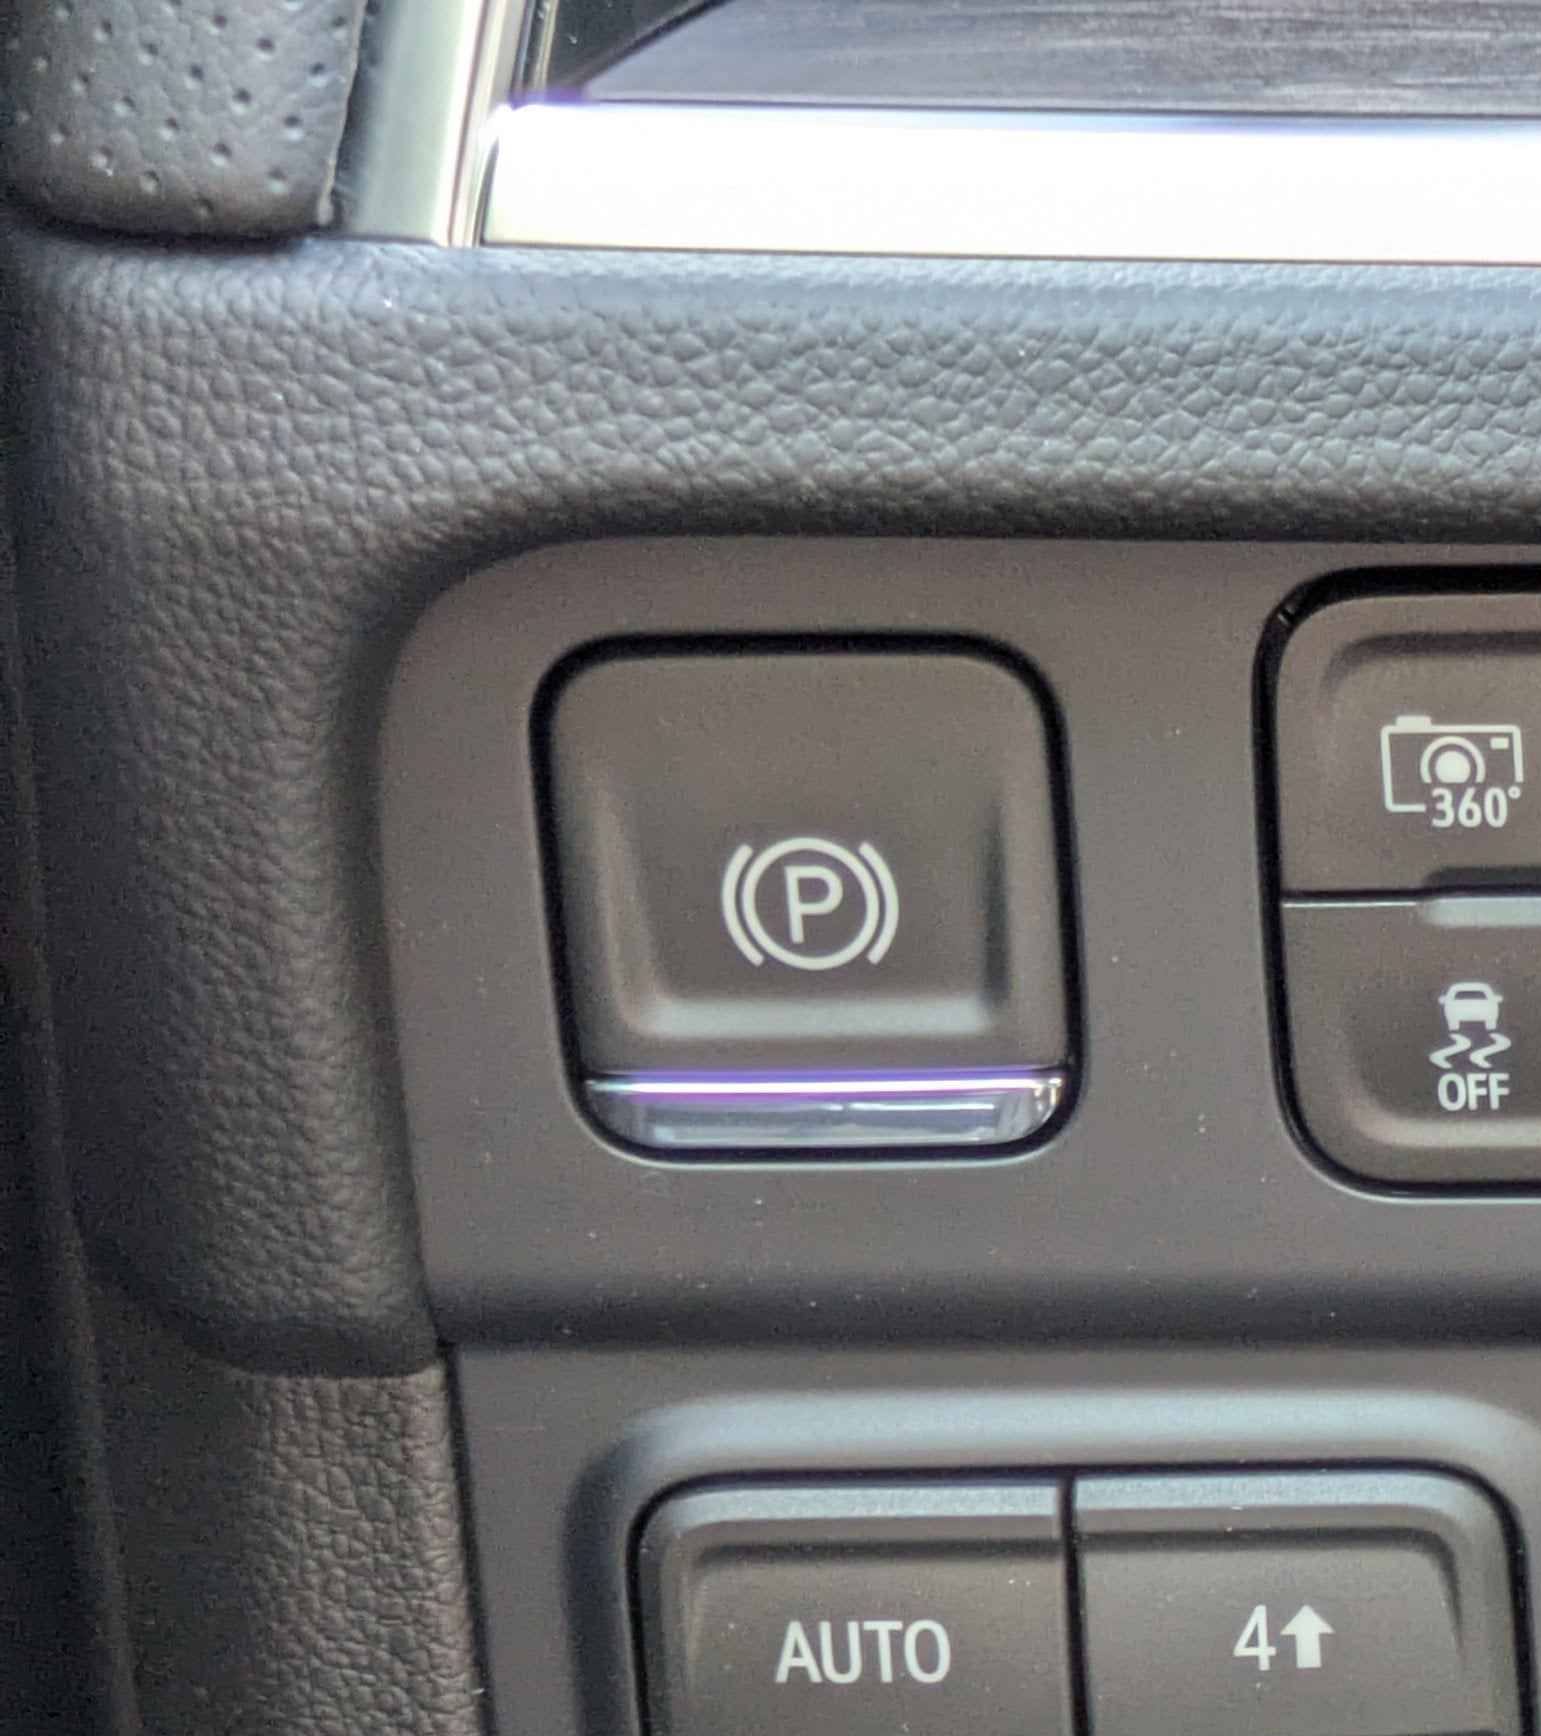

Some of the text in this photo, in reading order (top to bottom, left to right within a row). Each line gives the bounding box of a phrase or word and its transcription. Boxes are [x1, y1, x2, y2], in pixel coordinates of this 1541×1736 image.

[783, 864, 844, 944] P
[1437, 1073, 1511, 1111] OFF
[773, 1618, 952, 1685] AUTO
[1232, 1604, 1277, 1671] 4
